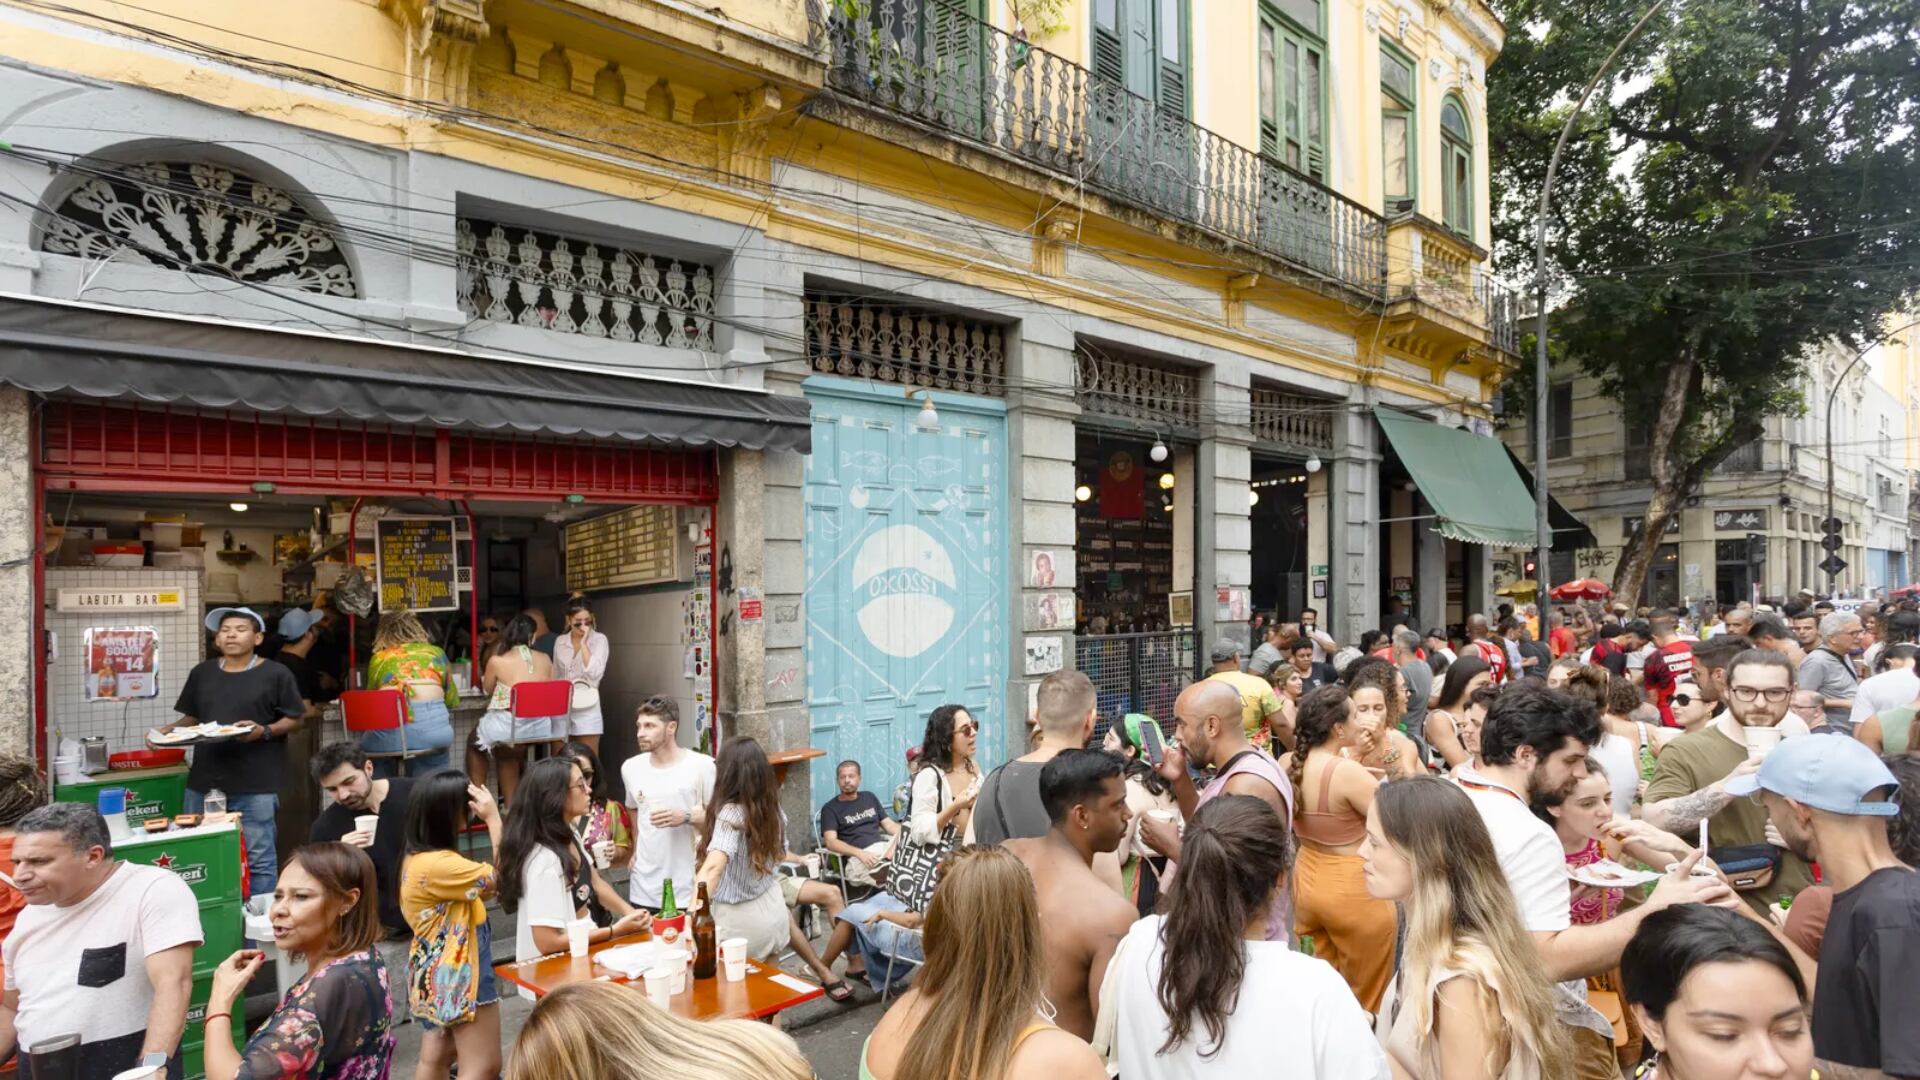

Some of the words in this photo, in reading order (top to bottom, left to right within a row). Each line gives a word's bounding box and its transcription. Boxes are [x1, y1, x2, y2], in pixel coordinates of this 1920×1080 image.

[78, 594, 124, 606] LABUTA
[136, 594, 158, 605] BAR
[125, 658, 144, 672] 14
